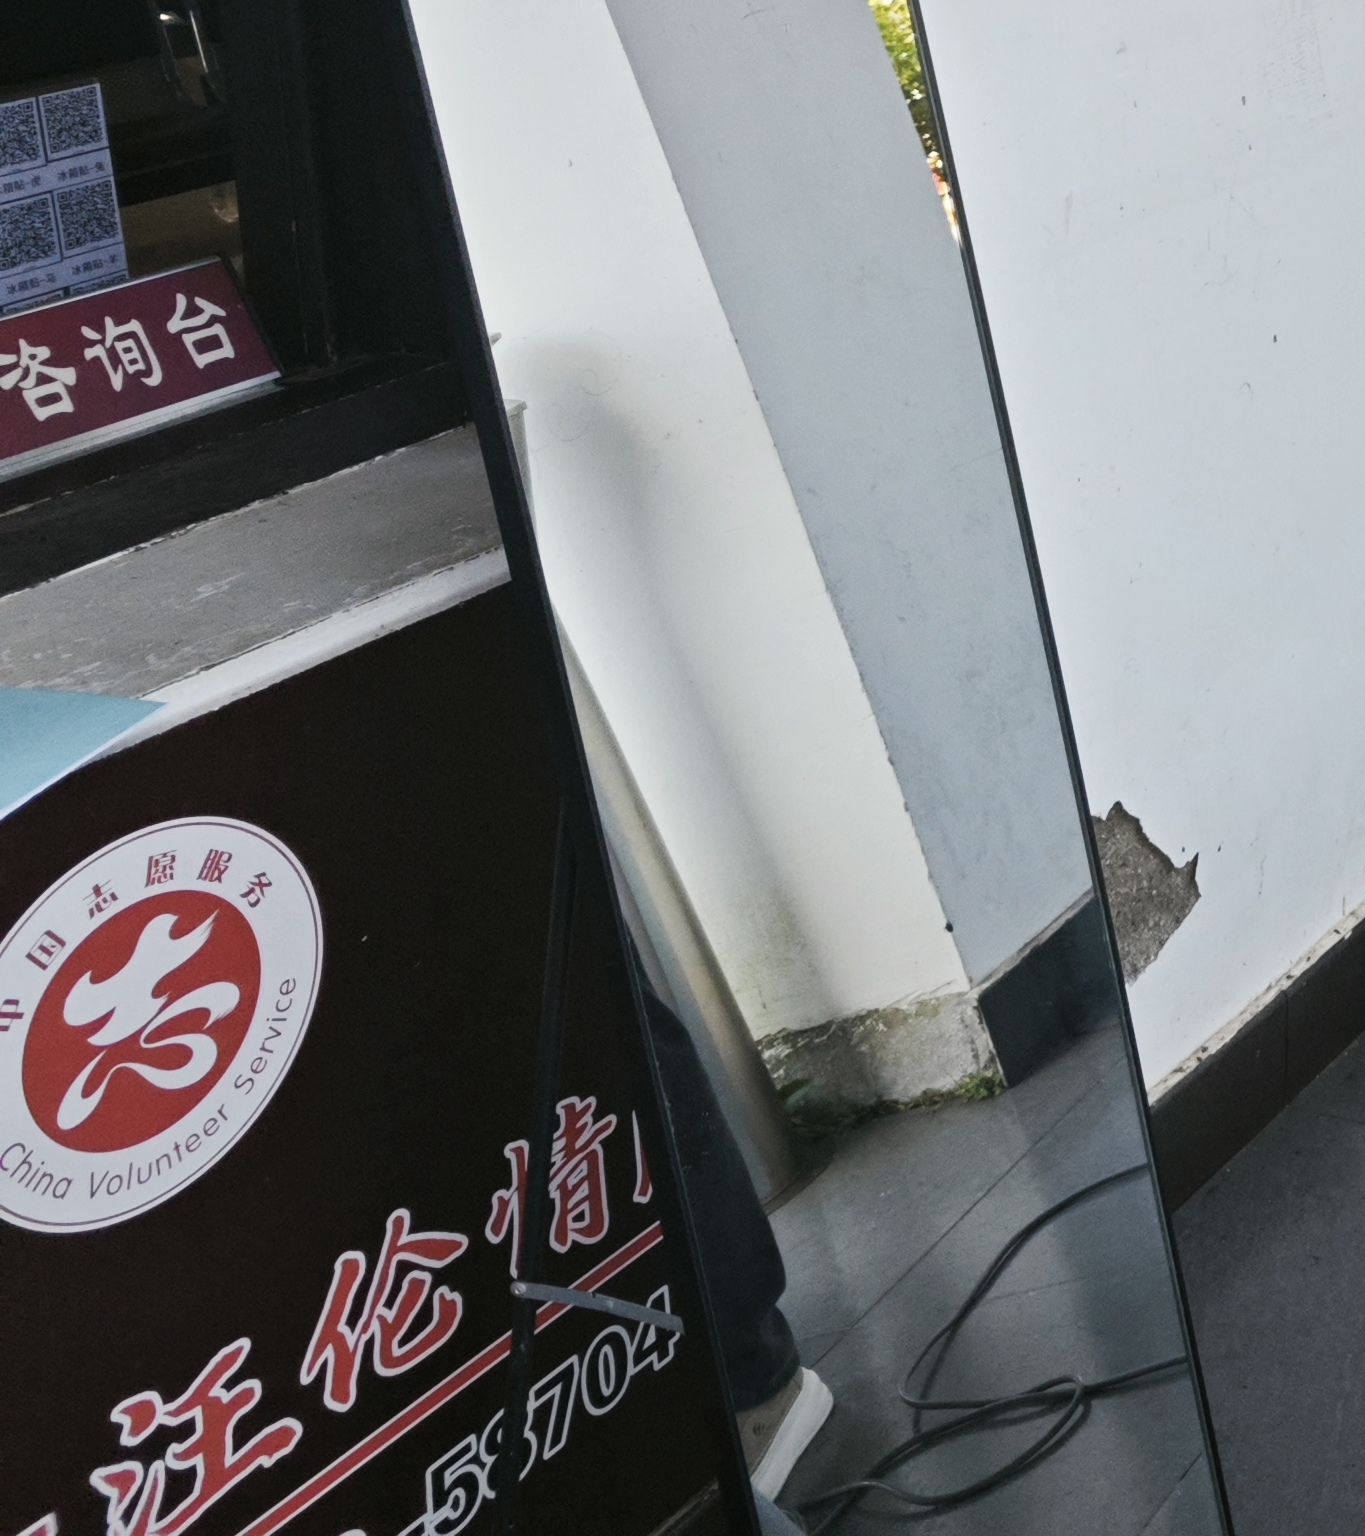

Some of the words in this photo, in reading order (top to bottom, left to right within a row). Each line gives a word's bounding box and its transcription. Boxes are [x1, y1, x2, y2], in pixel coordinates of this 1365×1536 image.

[0, 293, 236, 422] 咨询台
[0, 1141, 72, 1199] China
[88, 1102, 229, 1199] Volunteer
[234, 976, 297, 1095] Service
